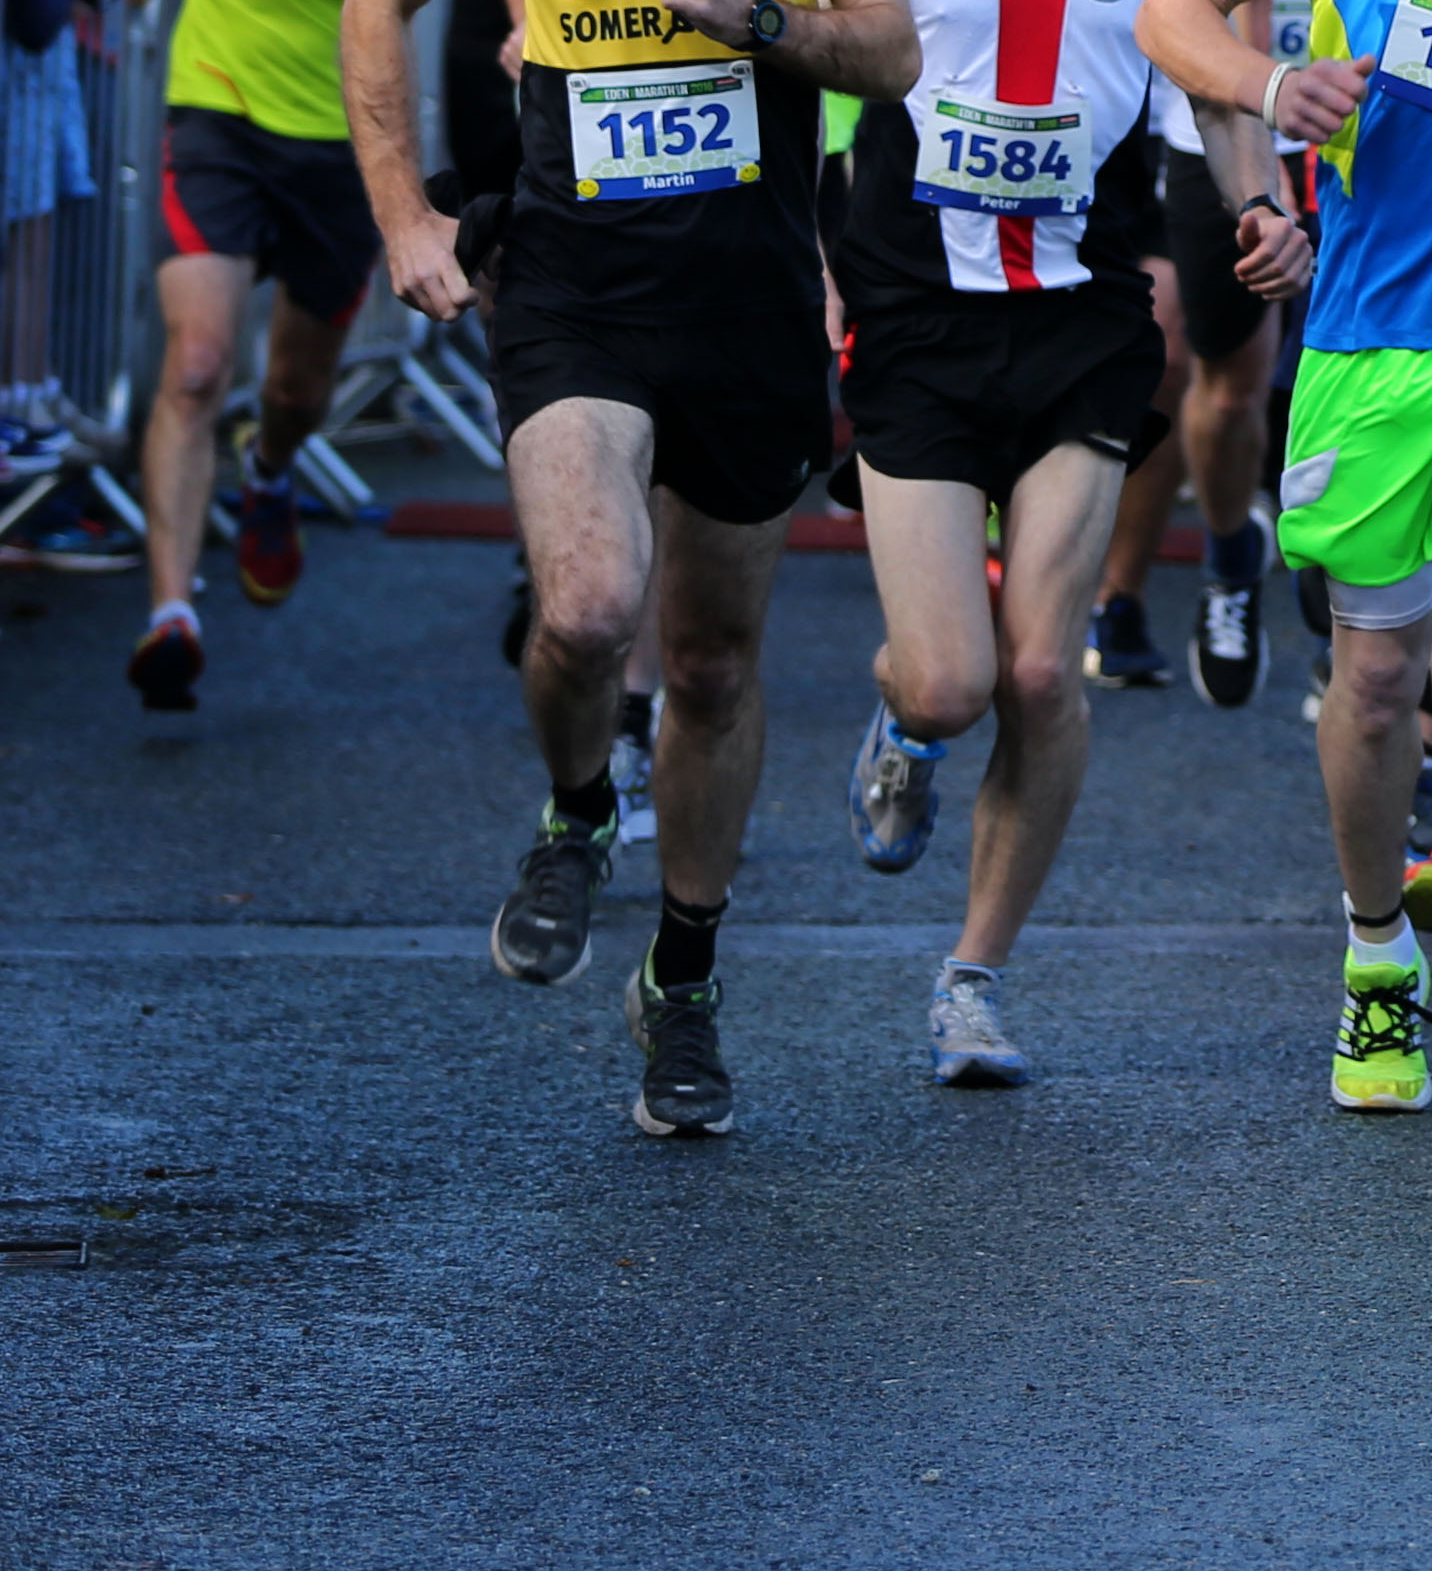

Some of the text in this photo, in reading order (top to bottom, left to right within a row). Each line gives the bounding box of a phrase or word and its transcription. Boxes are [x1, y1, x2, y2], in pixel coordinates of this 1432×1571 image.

[560, 6, 663, 43] SOMER
[604, 89, 629, 101] EDEN
[597, 103, 733, 159] 1152
[940, 130, 1071, 183] 1584
[643, 173, 695, 190] Martin
[980, 196, 1020, 211] Peter
